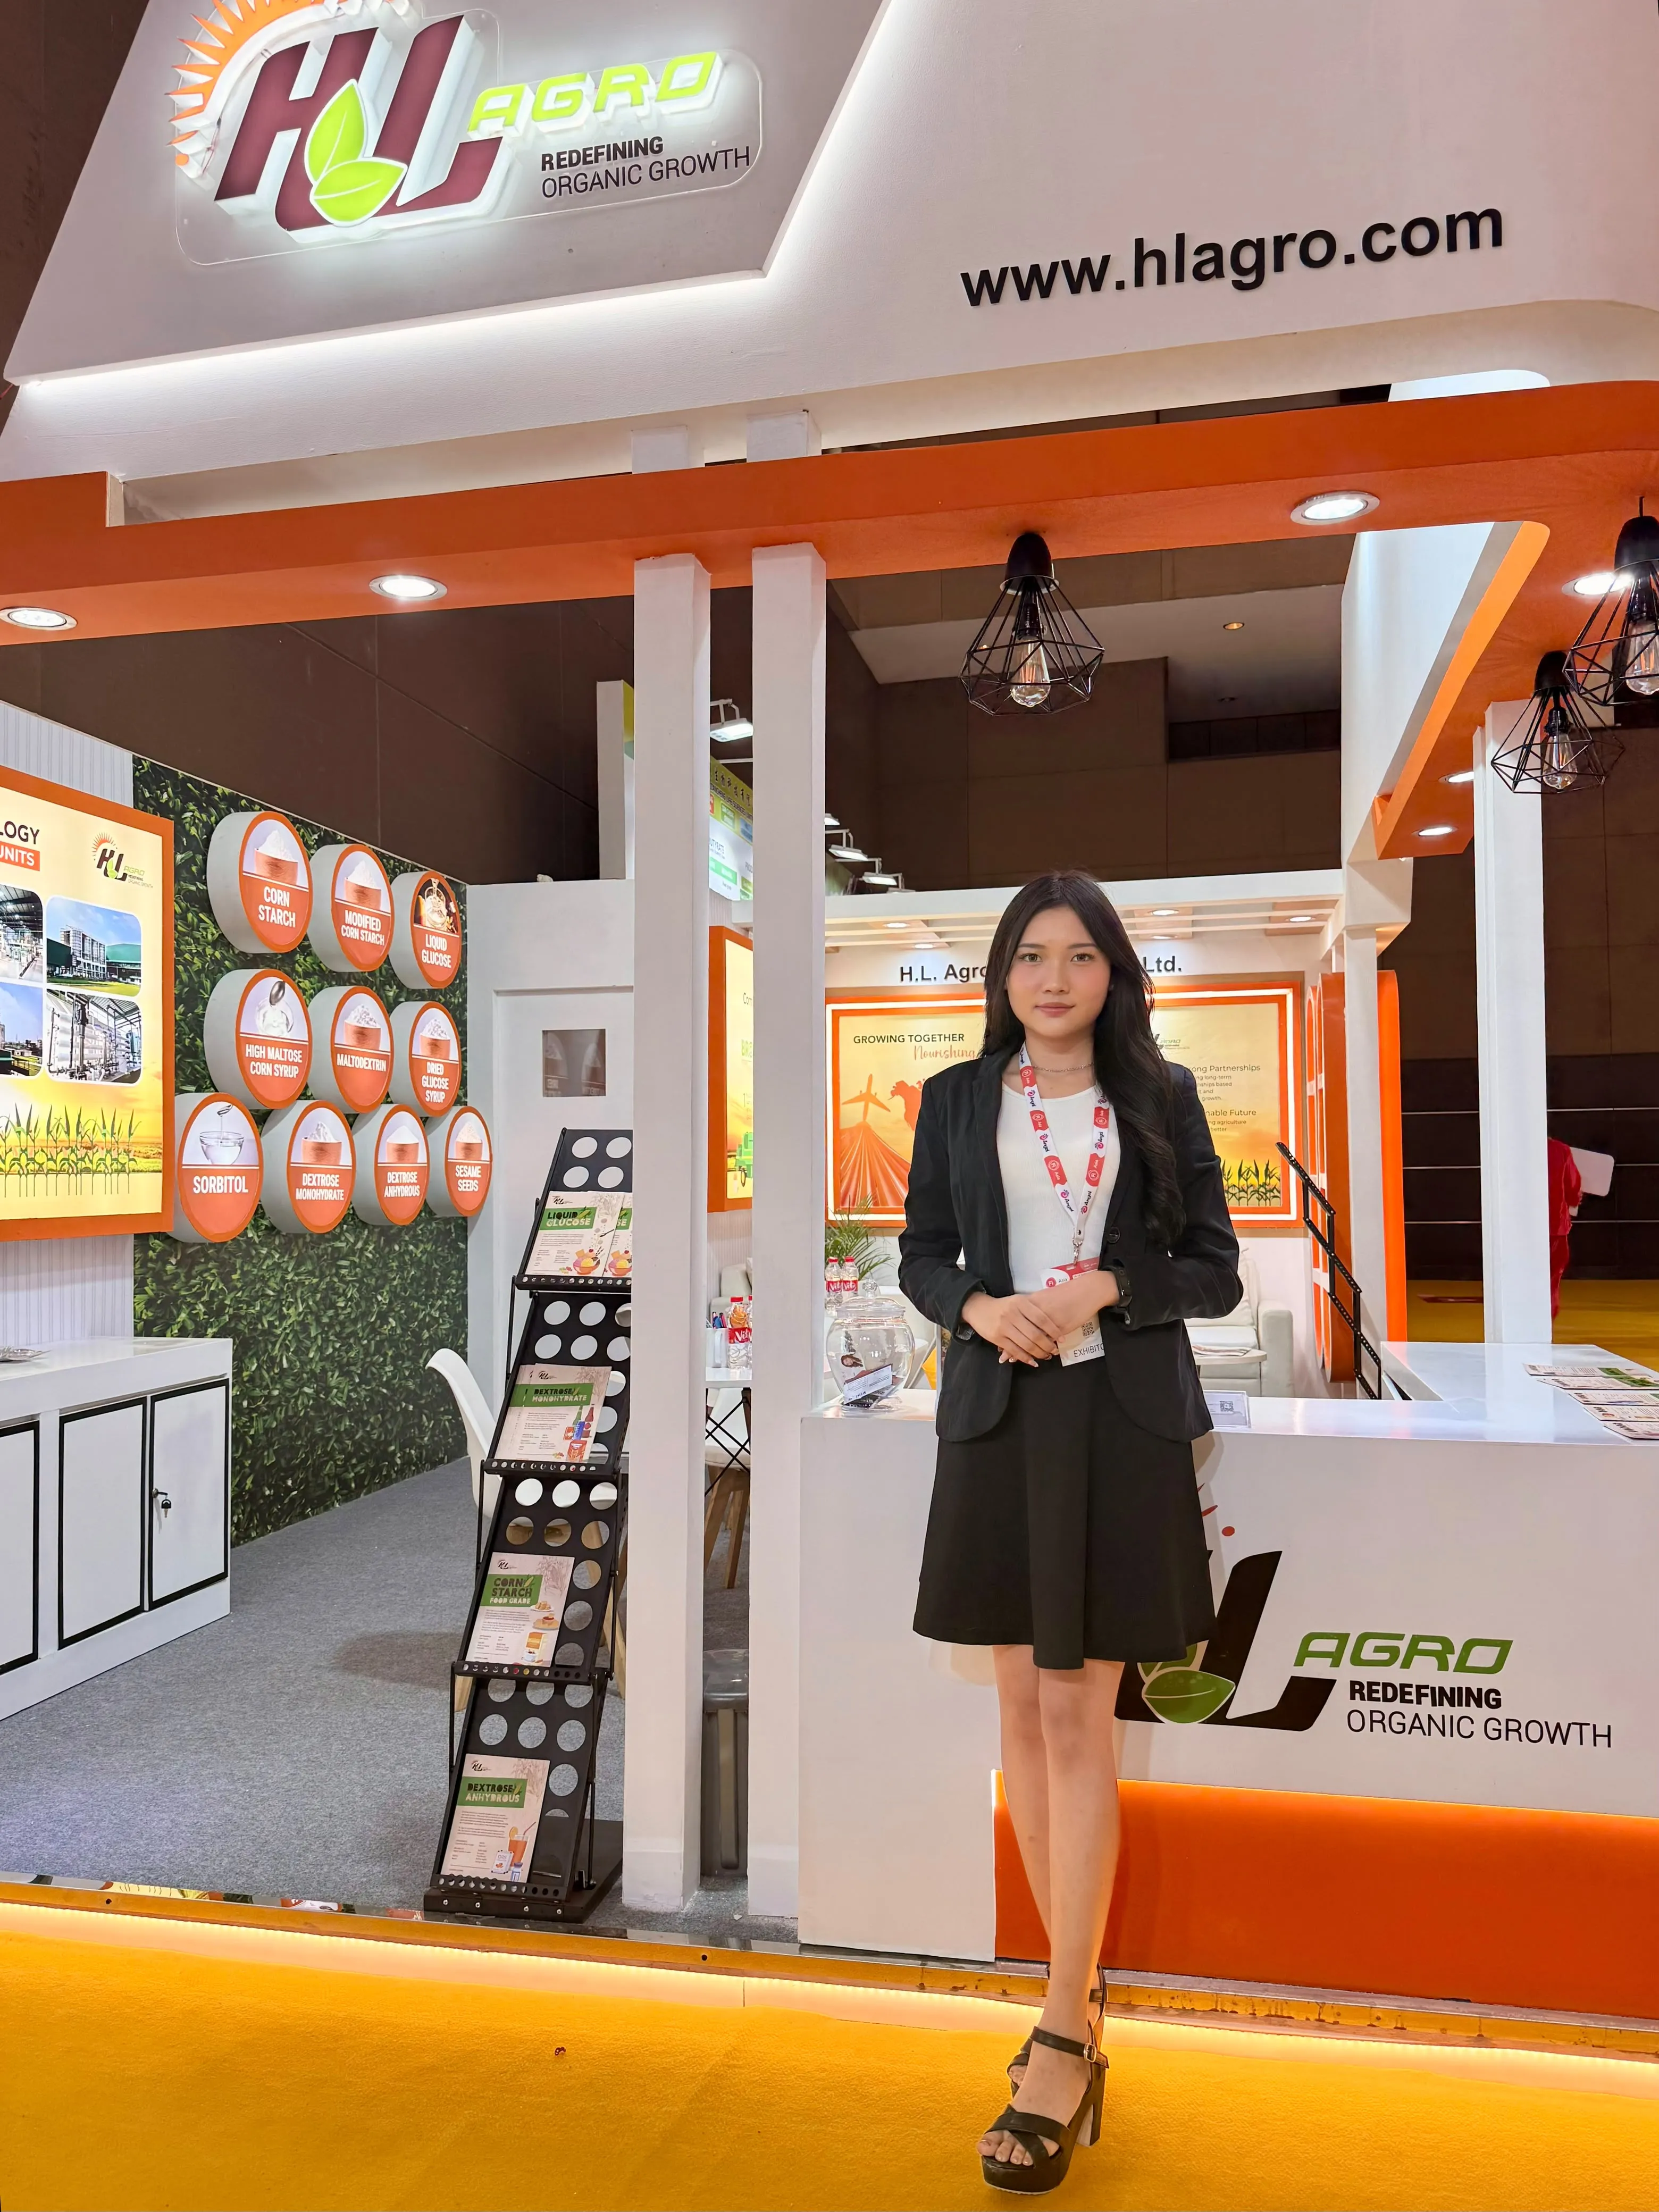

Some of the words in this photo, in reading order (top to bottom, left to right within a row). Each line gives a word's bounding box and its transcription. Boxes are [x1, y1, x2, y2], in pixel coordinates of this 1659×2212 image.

[467, 51, 720, 134] AGRO
[541, 136, 664, 171] REDEFINING
[541, 166, 642, 198] ORGANIC
[648, 146, 750, 181] GROWTH
[960, 208, 1502, 307] www.hlagro.com
[264, 886, 290, 908] CORN
[258, 904, 296, 927] STARCH
[345, 909, 381, 932] MODIFIED
[341, 925, 359, 939] CORN
[360, 931, 384, 946] STARCH
[425, 934, 447, 951] LIQUID
[422, 951, 451, 968] GLUCOSE
[1143, 956, 1182, 973] Ltd.
[900, 966, 937, 982] H.L.
[853, 1035, 905, 1044] GROWING
[908, 1034, 965, 1043] TOGETHER
[246, 1044, 265, 1058] HIGH
[267, 1046, 302, 1063] MALTOSE
[914, 1045, 976, 1060] Nourishing
[250, 1062, 272, 1076] CORN
[274, 1063, 299, 1078] SYRUP
[337, 1053, 386, 1072] MALTODEXTRIN
[427, 1062, 444, 1075] DRIED
[422, 1076, 449, 1090] GLUCOSE
[425, 1090, 445, 1103] SYRUP
[387, 1172, 417, 1184] DEXTROSE
[455, 1165, 481, 1178] SESAME
[193, 1176, 249, 1194] SORBITOL
[303, 1174, 339, 1187] DEXTROSE
[458, 1179, 479, 1192] SEEDS
[296, 1188, 345, 1201] MONOHYDRATE
[384, 1185, 420, 1197] ANHYDROUS
[546, 1218, 591, 1227] GLUCOSE
[547, 1211, 578, 1220] LIQUID
[493, 1578, 523, 1587] CORN
[492, 1588, 533, 1597] STARCH
[1294, 1632, 1513, 1674] AGRO
[1350, 1680, 1502, 1710] REDEFINING
[1347, 1710, 1474, 1739] ORGANIC
[1484, 1717, 1612, 1748] GROWTH
[467, 1783, 513, 1792] DEXTROSE
[465, 1792, 520, 1803] ANHYDROUS
